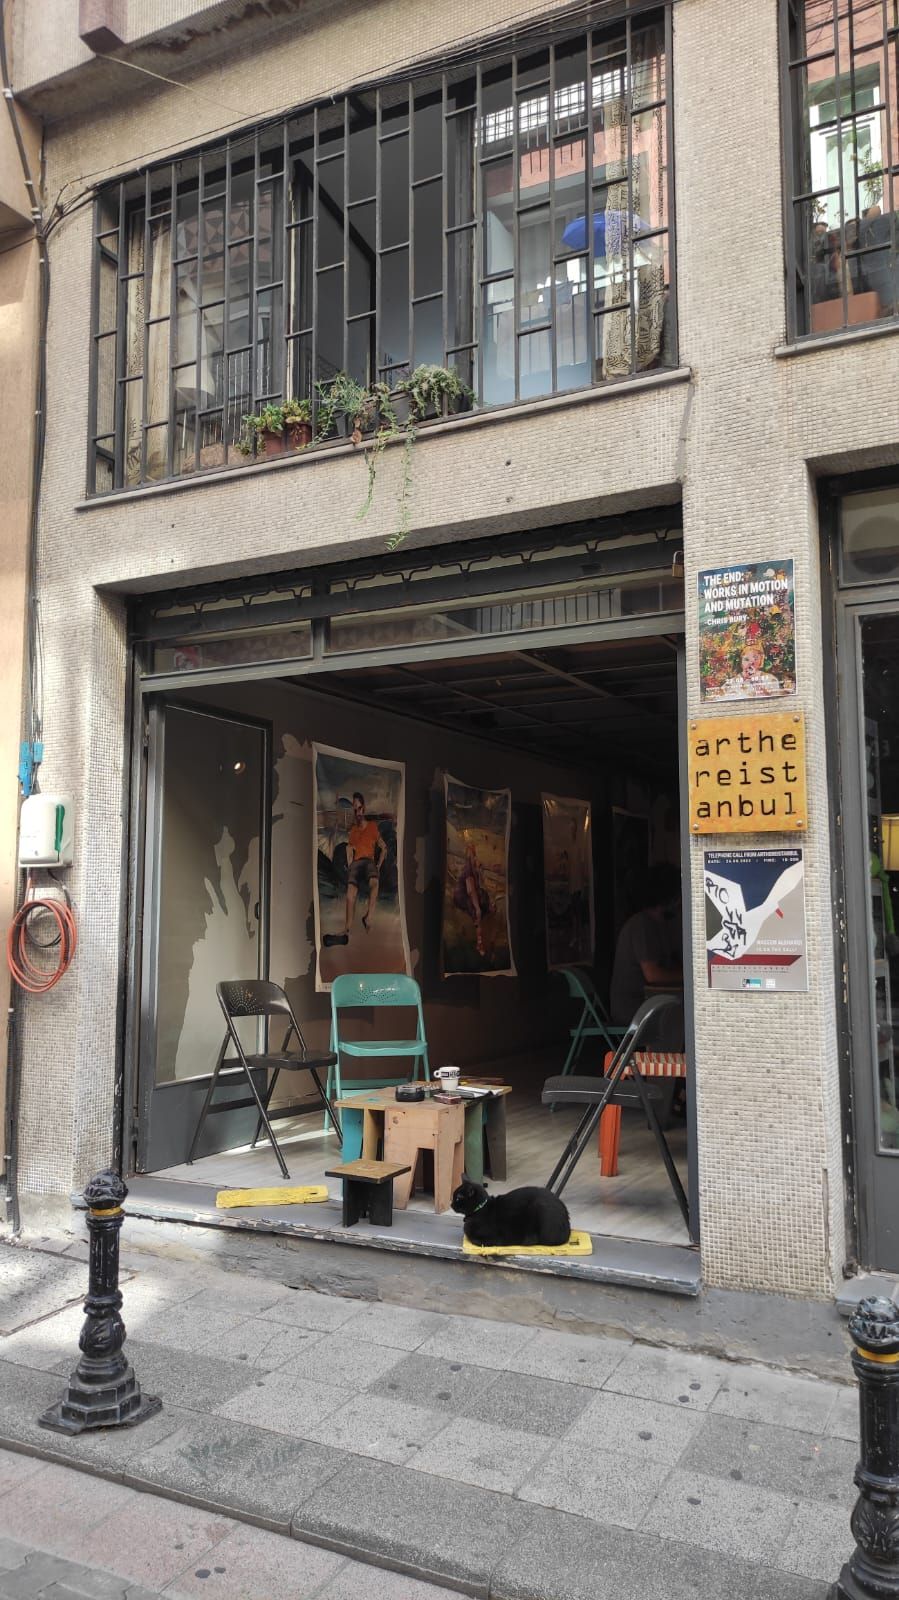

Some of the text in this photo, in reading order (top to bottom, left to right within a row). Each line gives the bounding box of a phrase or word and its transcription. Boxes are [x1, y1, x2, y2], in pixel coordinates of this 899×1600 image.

[704, 571, 744, 586] THE END:
[704, 578, 788, 599] WORKS IN MOTION
[704, 593, 774, 612] AND MUTATION
[695, 730, 797, 756] arthe
[695, 761, 798, 788] reist
[696, 792, 797, 818] anbul
